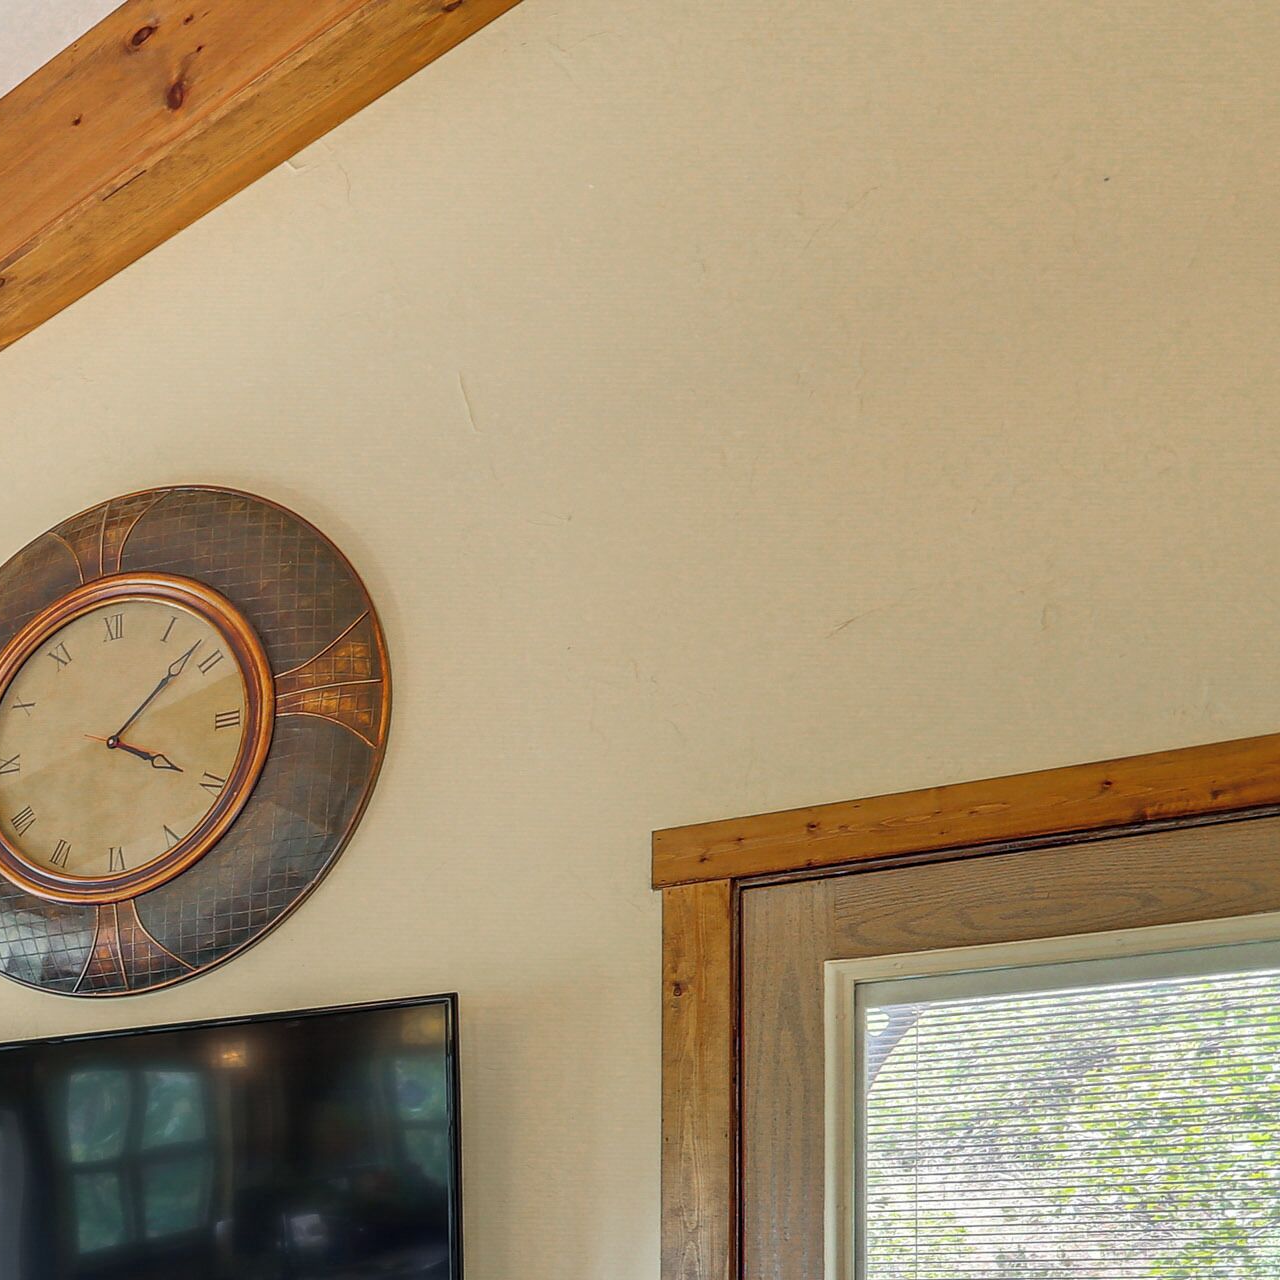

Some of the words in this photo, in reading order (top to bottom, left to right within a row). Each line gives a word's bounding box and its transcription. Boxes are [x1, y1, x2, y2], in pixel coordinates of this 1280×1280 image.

[103, 613, 125, 642] XII
[160, 616, 178, 643] I
[47, 641, 73, 672] XI
[197, 648, 224, 676] II
[11, 696, 36, 717] X
[215, 709, 240, 731] III
[10, 805, 37, 837] VIII
[49, 839, 72, 869] VII
[108, 846, 127, 873] VI
